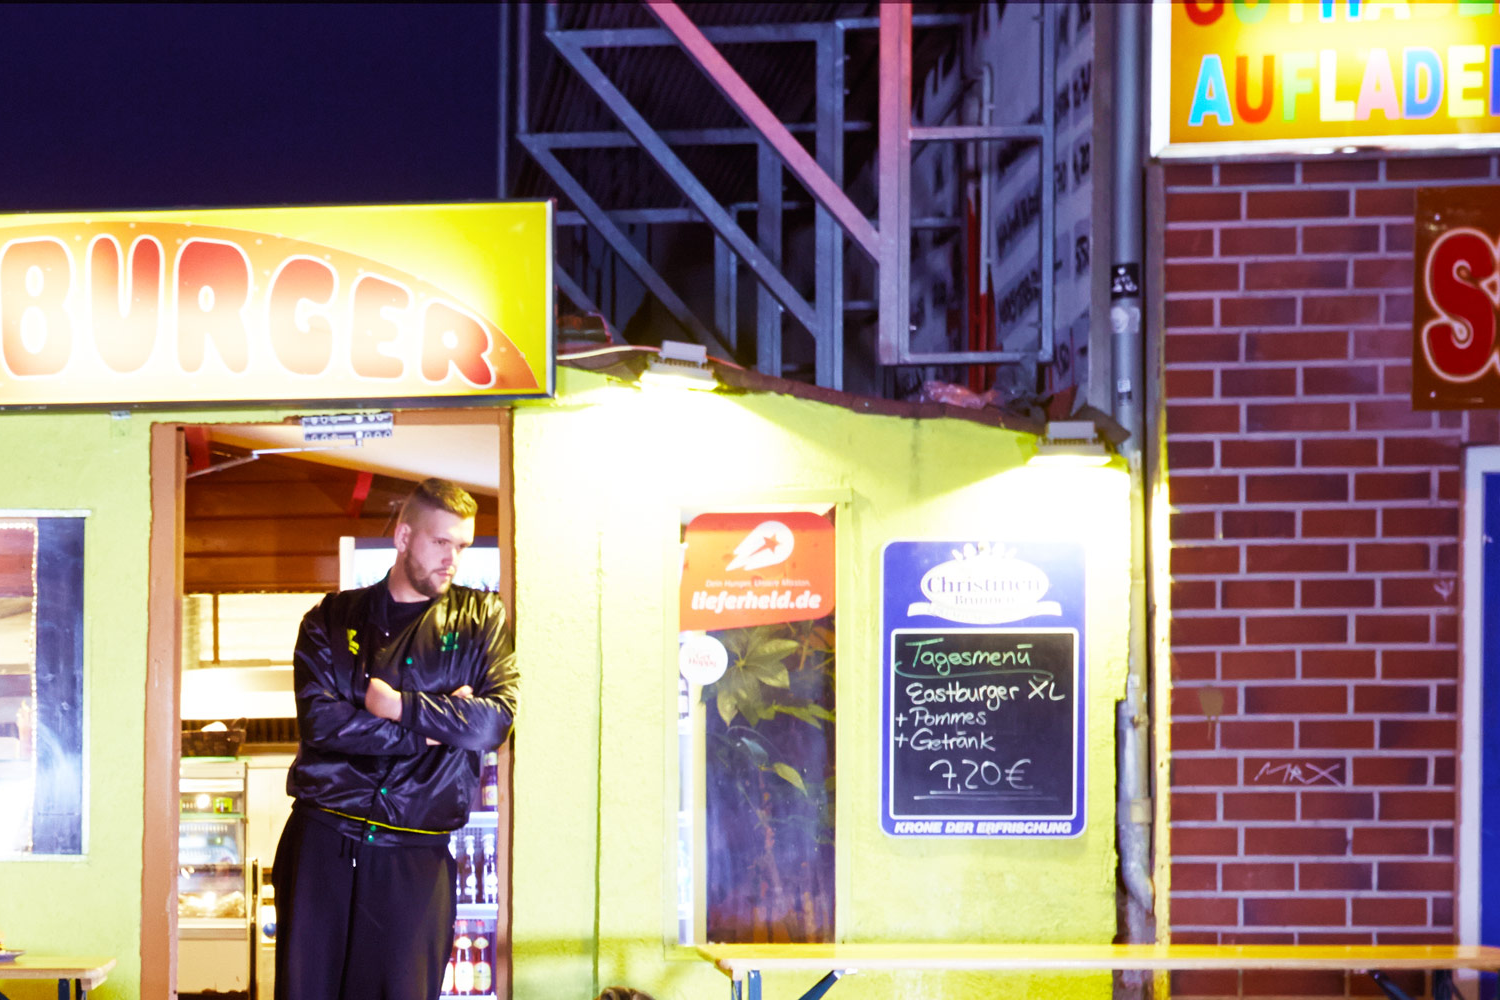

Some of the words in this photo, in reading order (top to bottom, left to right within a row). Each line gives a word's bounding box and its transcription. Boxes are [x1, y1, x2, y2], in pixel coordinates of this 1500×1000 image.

[1188, 44, 1500, 127] AUFLADE
[1422, 227, 1500, 383] S
[927, 576, 1040, 593] Christinen
[691, 590, 822, 614] lieferheld.de
[906, 681, 1020, 711] Eastburger
[1028, 679, 1066, 701] XL
[894, 821, 944, 834] KRONE
[944, 821, 975, 834] DER
[976, 821, 1073, 835] ERFRISCHUNG
